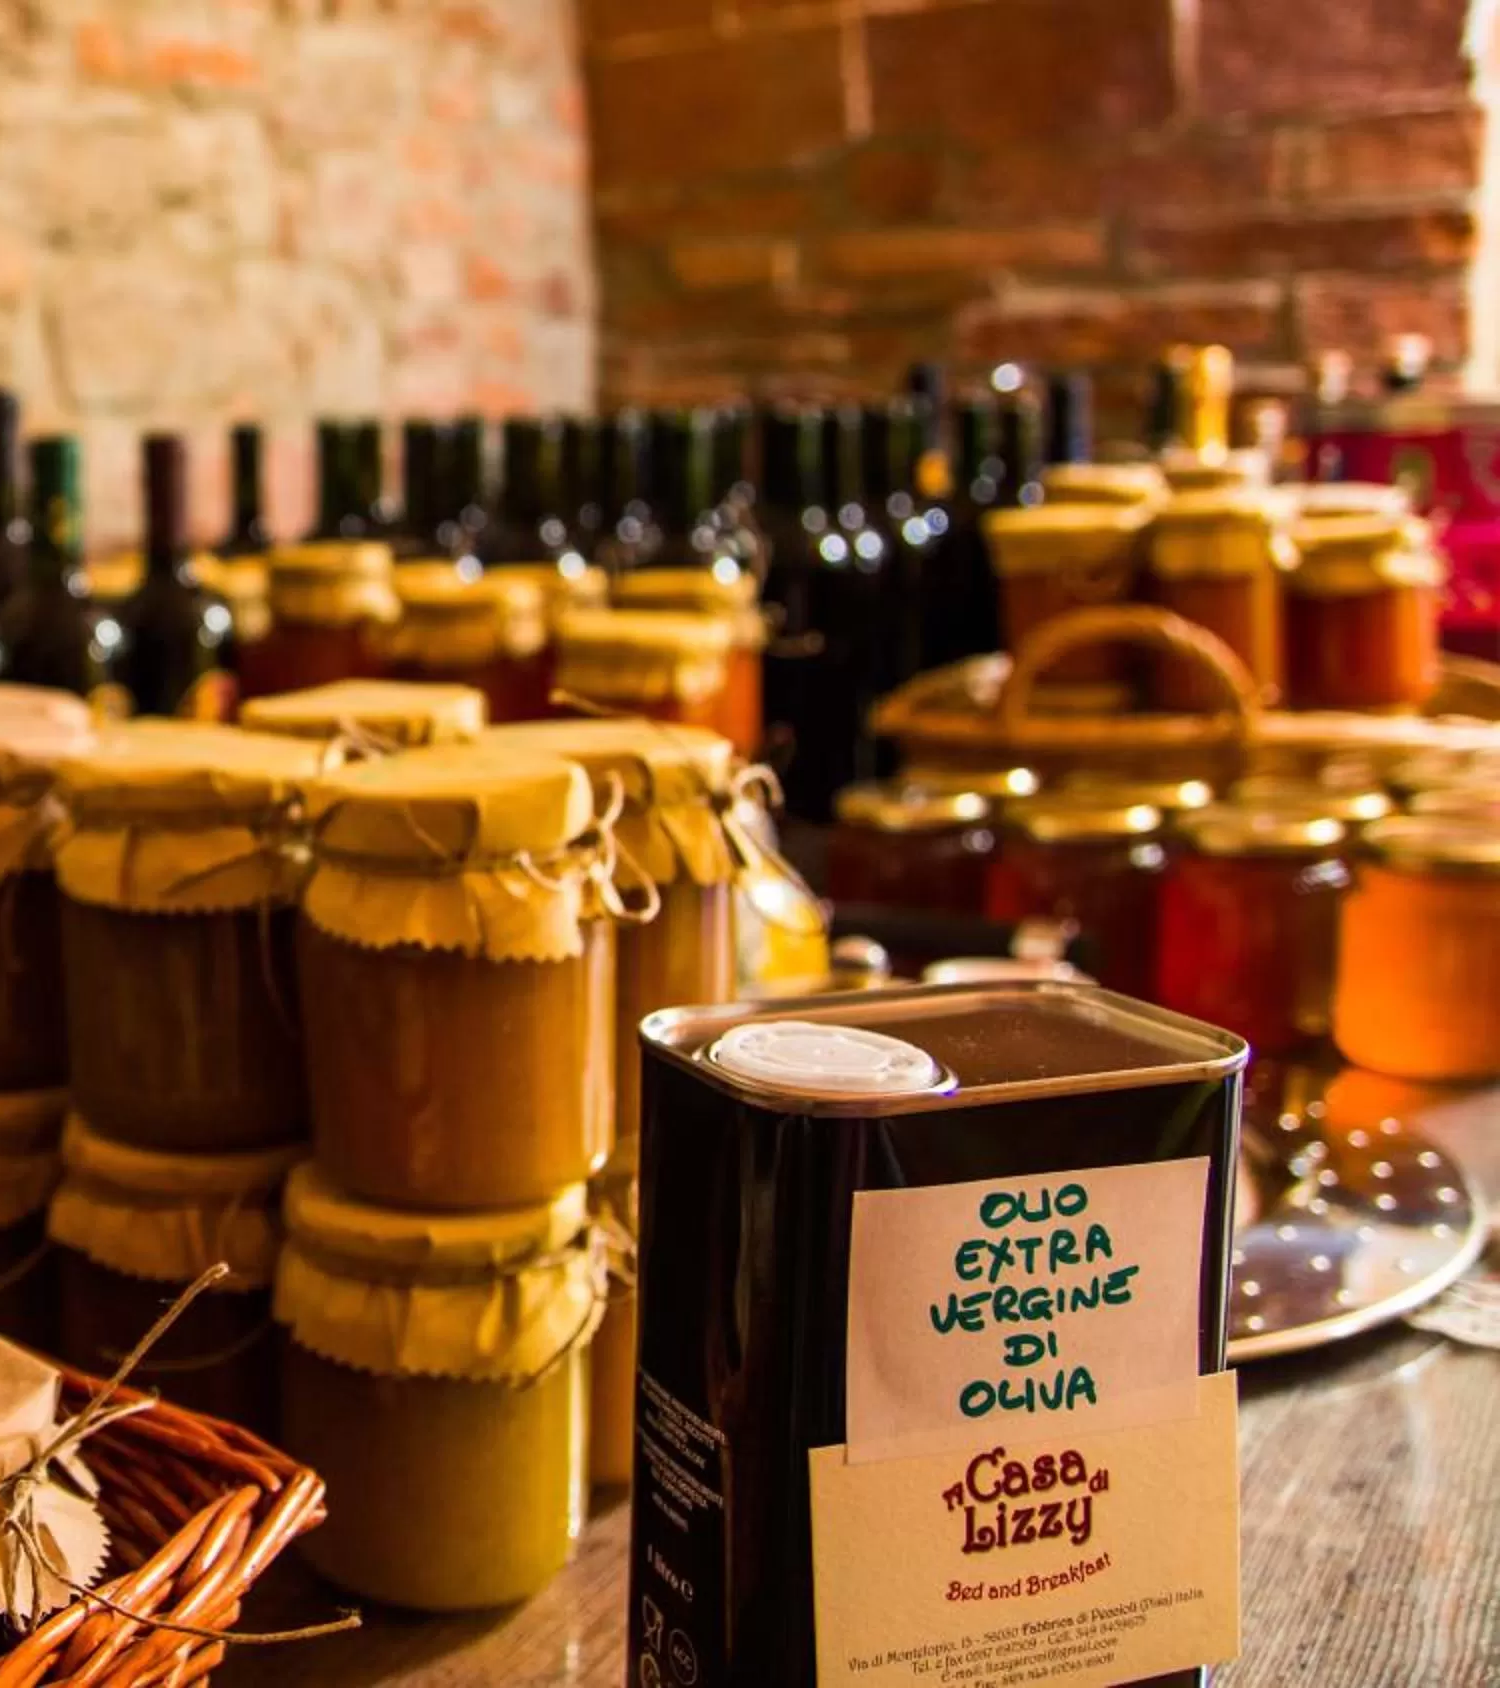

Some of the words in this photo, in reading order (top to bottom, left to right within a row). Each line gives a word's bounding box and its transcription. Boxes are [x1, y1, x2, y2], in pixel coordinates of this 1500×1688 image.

[980, 1184, 1088, 1228] OLIO
[955, 1224, 1112, 1284] EXTRA
[930, 1265, 1140, 1334] VERGINE
[1003, 1331, 1058, 1367] DI
[959, 1366, 1097, 1418] OLIVA
[965, 1446, 1088, 1503] Casa
[1088, 1467, 1109, 1494] di
[961, 1496, 1092, 1554] Lizzy
[945, 1579, 984, 1602] Bed
[988, 1578, 1022, 1599] and
[1025, 1551, 1112, 1597] Breakfast
